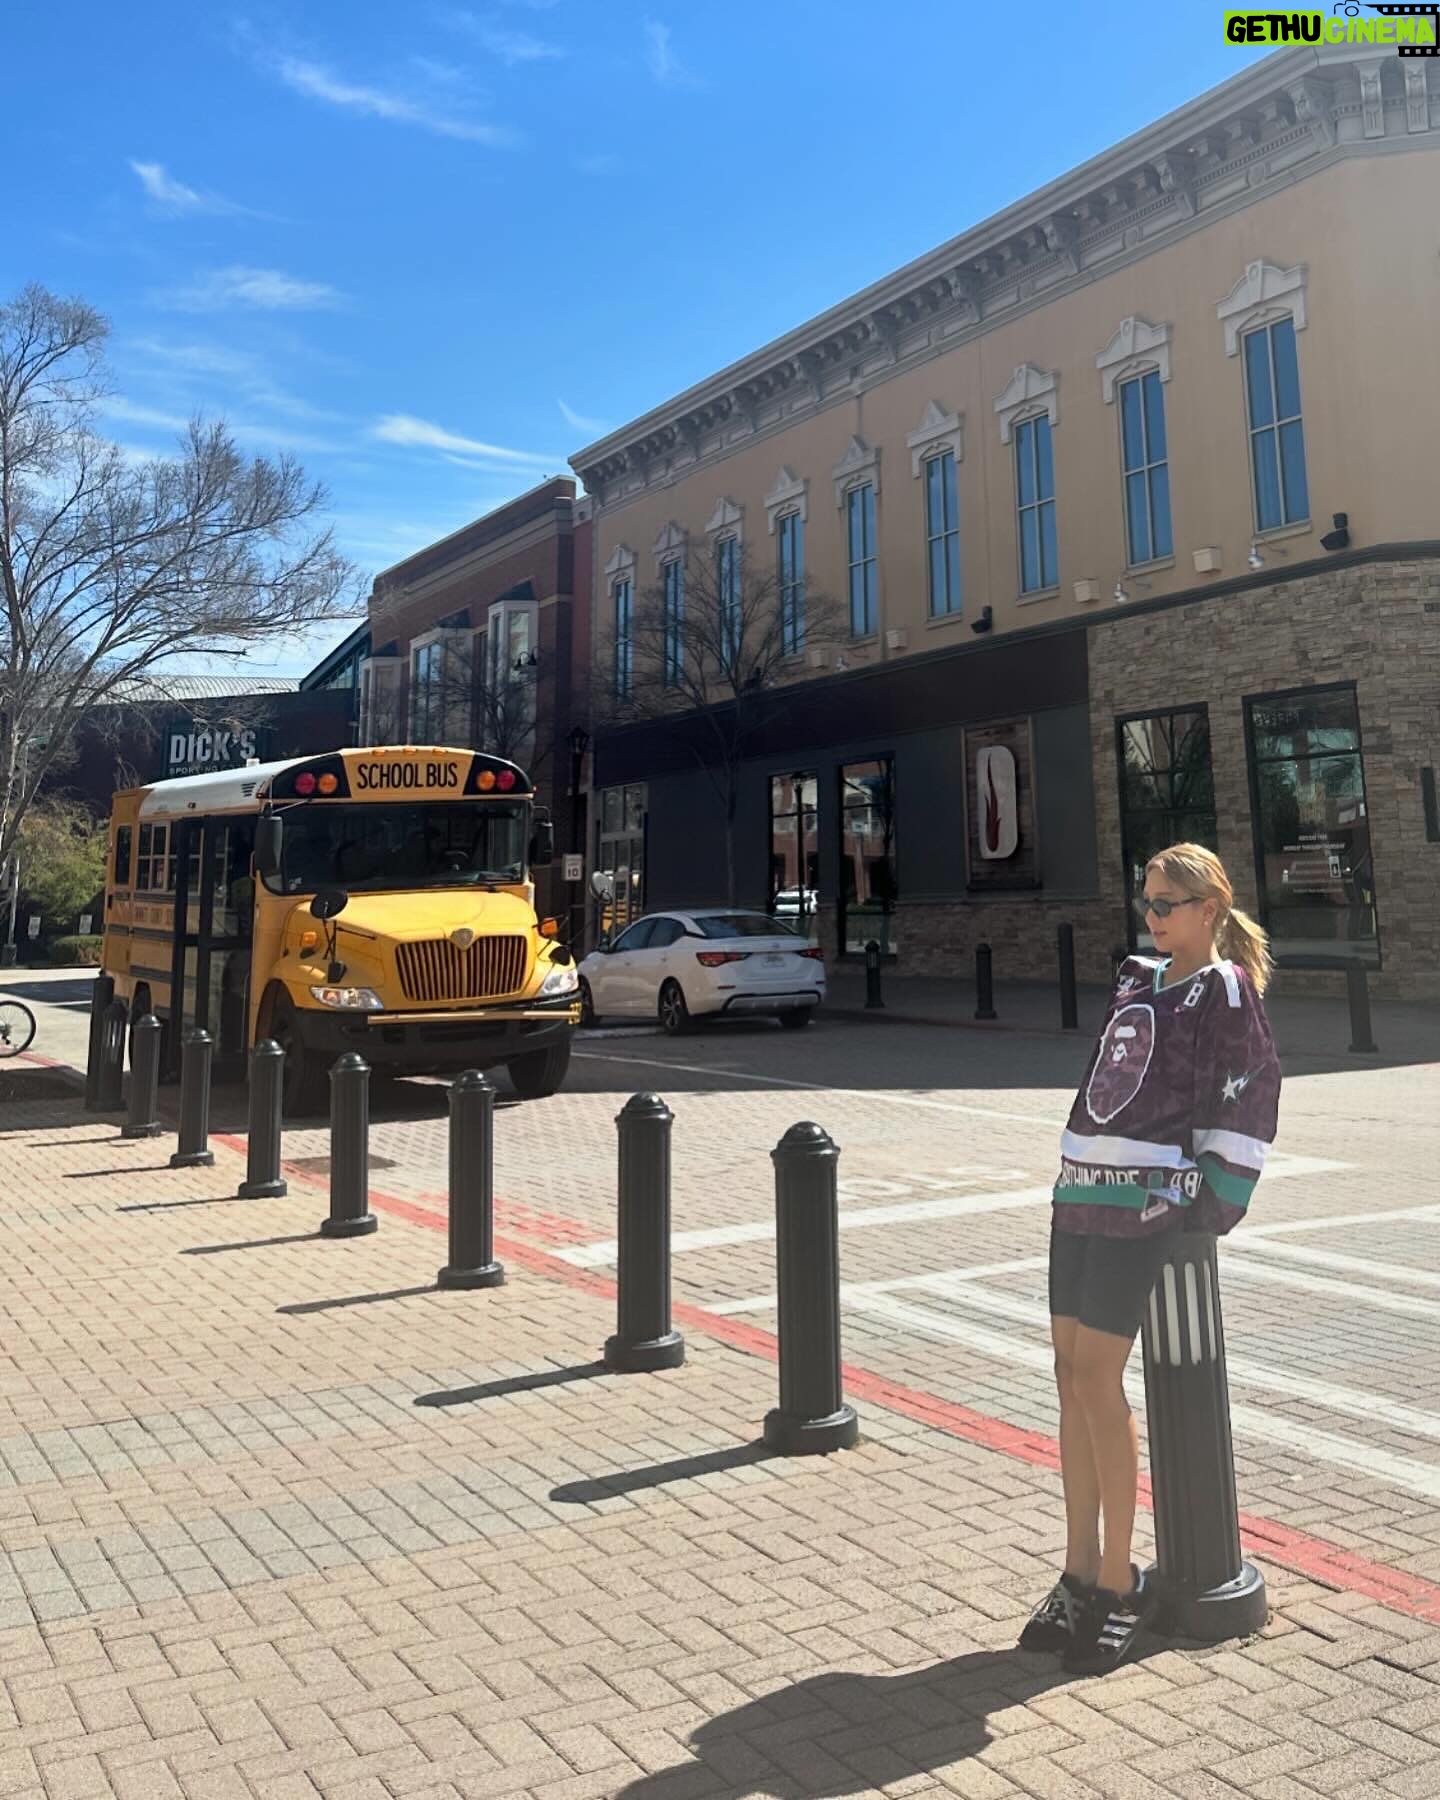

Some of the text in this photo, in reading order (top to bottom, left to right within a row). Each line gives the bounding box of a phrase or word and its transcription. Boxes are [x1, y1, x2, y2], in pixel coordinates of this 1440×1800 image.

[169, 730, 256, 764] DICK'S
[357, 762, 458, 789] SCHOOL BUS
